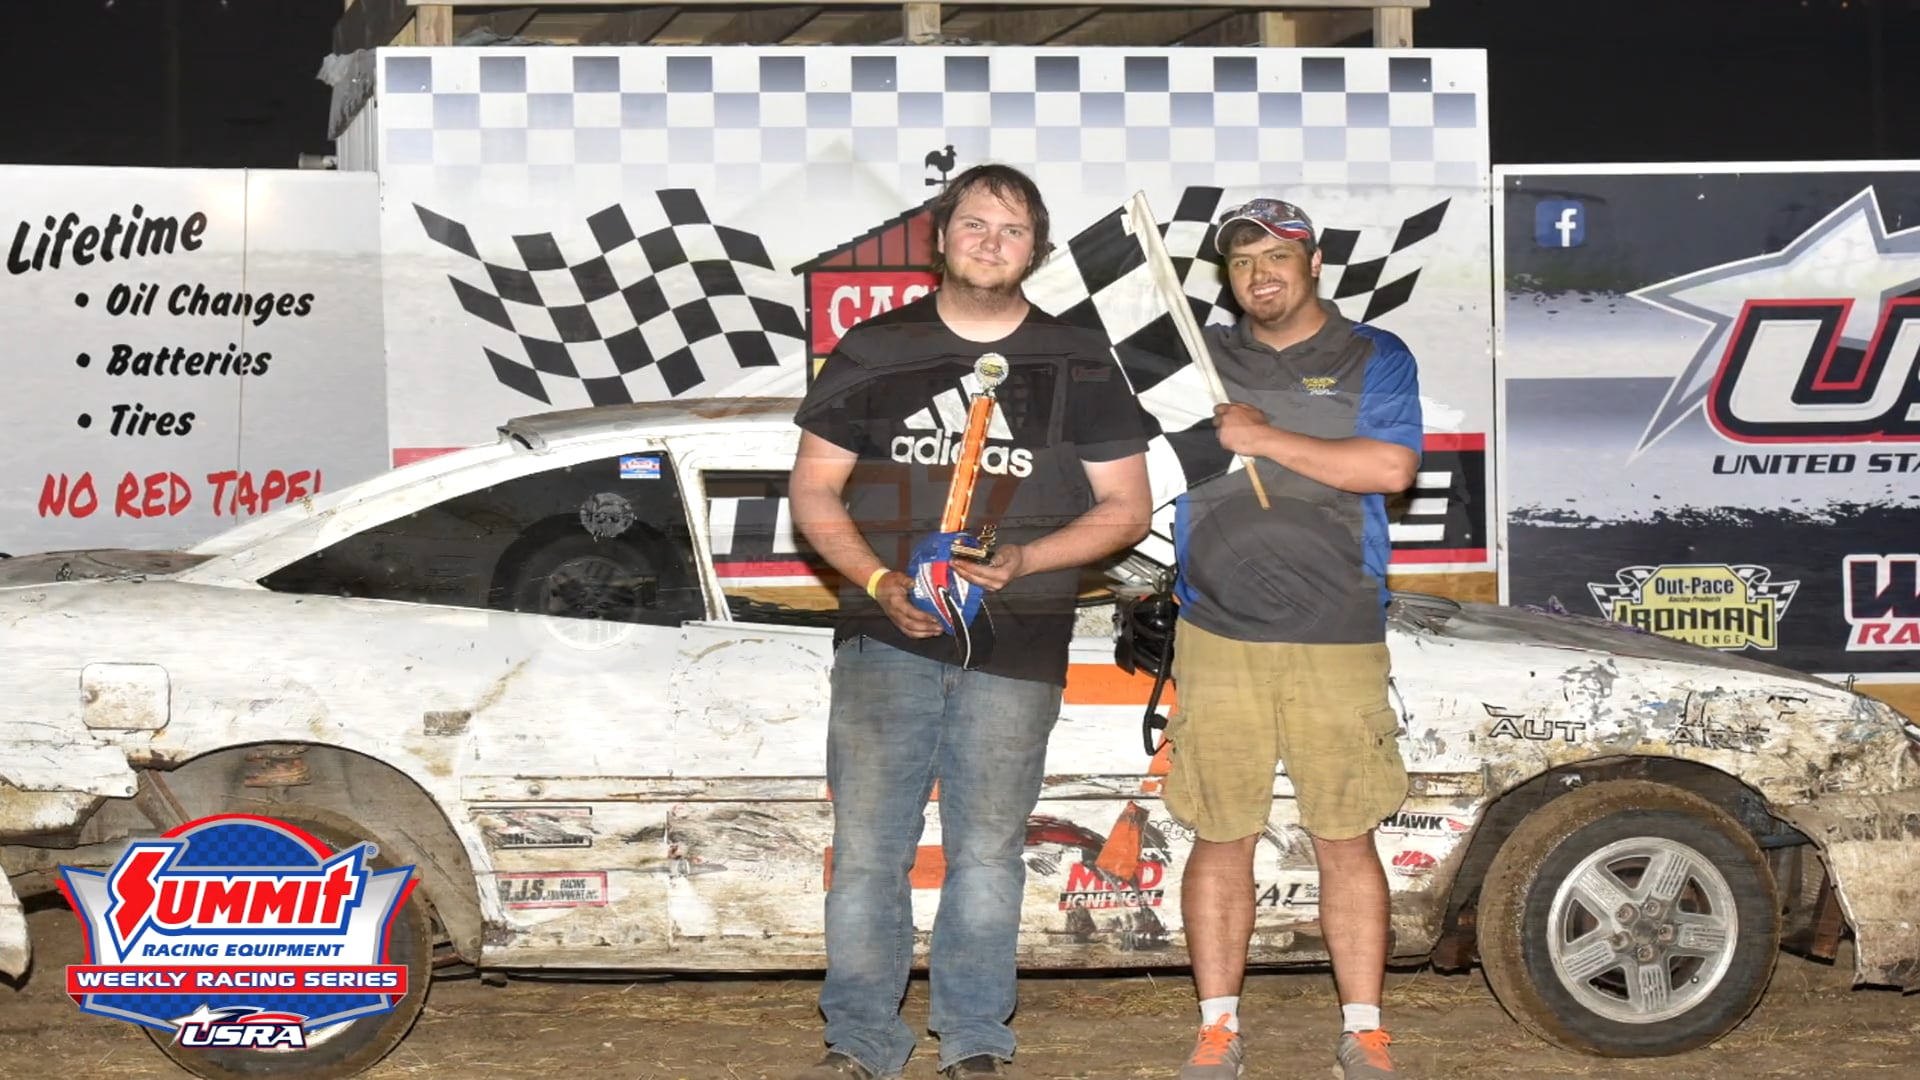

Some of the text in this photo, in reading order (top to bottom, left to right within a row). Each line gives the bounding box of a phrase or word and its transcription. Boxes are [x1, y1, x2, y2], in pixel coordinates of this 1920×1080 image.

[7, 204, 207, 275] Lifetime
[106, 283, 315, 326] Oil Changes
[106, 343, 272, 376] Batteries
[110, 403, 195, 437] Tires
[1713, 453, 1920, 475] UNITED ST
[38, 472, 99, 518] NO
[115, 472, 192, 518] RED
[1655, 576, 1734, 596] Out-Pace
